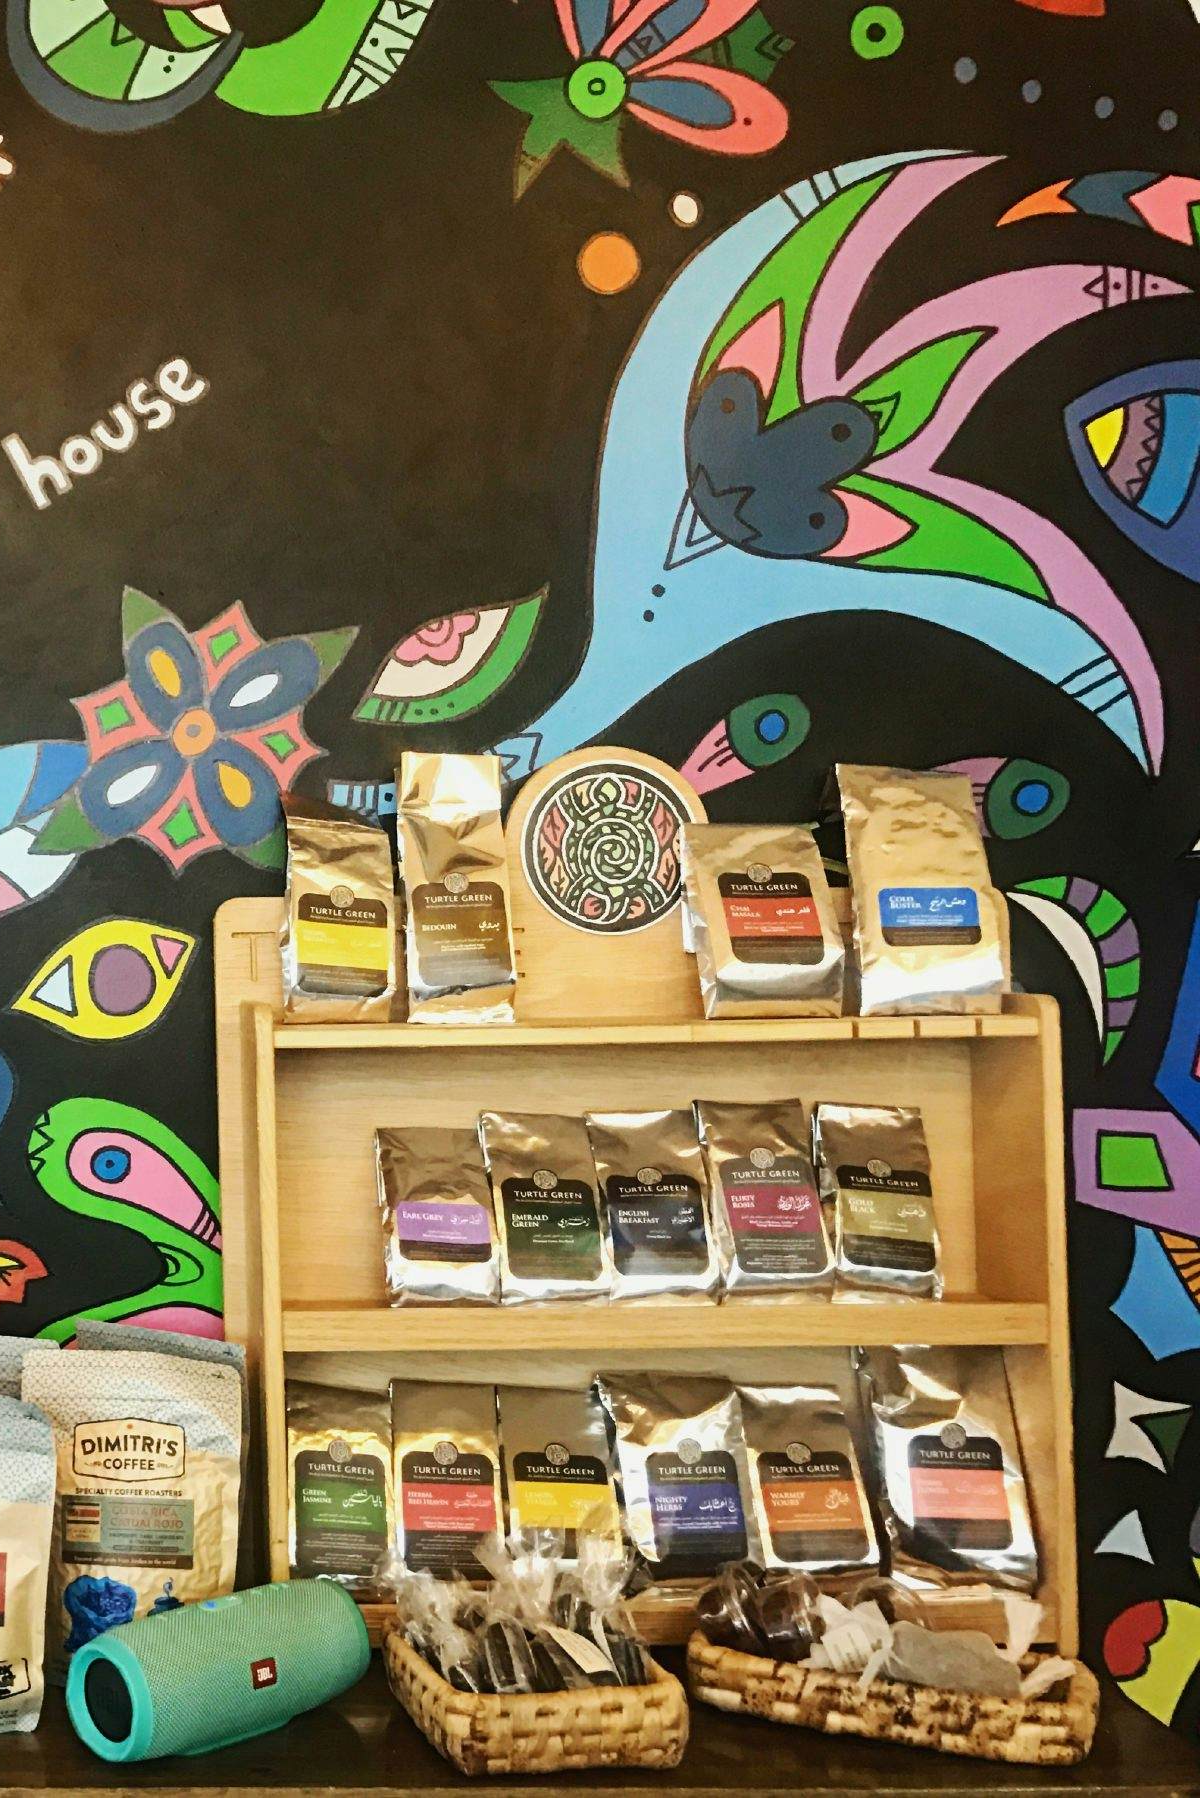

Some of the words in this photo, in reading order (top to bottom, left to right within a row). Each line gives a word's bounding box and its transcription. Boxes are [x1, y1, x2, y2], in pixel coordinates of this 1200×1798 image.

[4, 357, 206, 509] house
[424, 895, 459, 904] TURTLE
[461, 894, 493, 902] GREEN
[889, 895, 914, 903] COLD
[890, 902, 922, 910] BUSTER
[310, 906, 342, 917] TURTLE
[345, 909, 376, 919] GREEN
[731, 1170, 766, 1179] TURTLE
[768, 1169, 800, 1178] GREEN
[850, 1175, 885, 1185] TURTLE
[886, 1179, 919, 1187] GREEN
[618, 1185, 653, 1193] TURTLE
[656, 1184, 688, 1192] GREEN
[513, 1190, 548, 1199] TURTLE
[550, 1191, 583, 1199] GREEN
[402, 1210, 422, 1220] EARL
[422, 1213, 444, 1221] GREY
[511, 1213, 549, 1221] EMERALD
[618, 1209, 650, 1217] ENGLISH
[511, 1220, 540, 1228] GREEN
[80, 1434, 179, 1457] DIMITRI'S
[919, 1449, 955, 1459] TURTLE
[957, 1451, 991, 1460] GREEN
[102, 1457, 156, 1471] COFFEE
[769, 1465, 805, 1474] TURTLE
[806, 1463, 840, 1472] GREEN
[308, 1463, 342, 1473] TURTLE
[344, 1465, 375, 1476] GREEN
[413, 1465, 447, 1475] TURTLE
[449, 1467, 481, 1476] GREEN
[526, 1465, 560, 1474] TURTLE
[563, 1467, 595, 1475] GREEN
[658, 1466, 693, 1475] TURTLE
[695, 1465, 726, 1474] GREEN
[75, 1487, 113, 1495] SPECIALTY
[114, 1488, 143, 1496] COFFEE
[144, 1489, 183, 1497] ROASTERS
[302, 1488, 327, 1496] GREEN
[769, 1491, 806, 1500] WARMLY
[302, 1495, 332, 1504] JASMINE
[654, 1495, 688, 1503] NIGHTY
[771, 1499, 800, 1507] YOURS
[656, 1503, 683, 1512] HERBS
[256, 1666, 274, 1682] JBL
